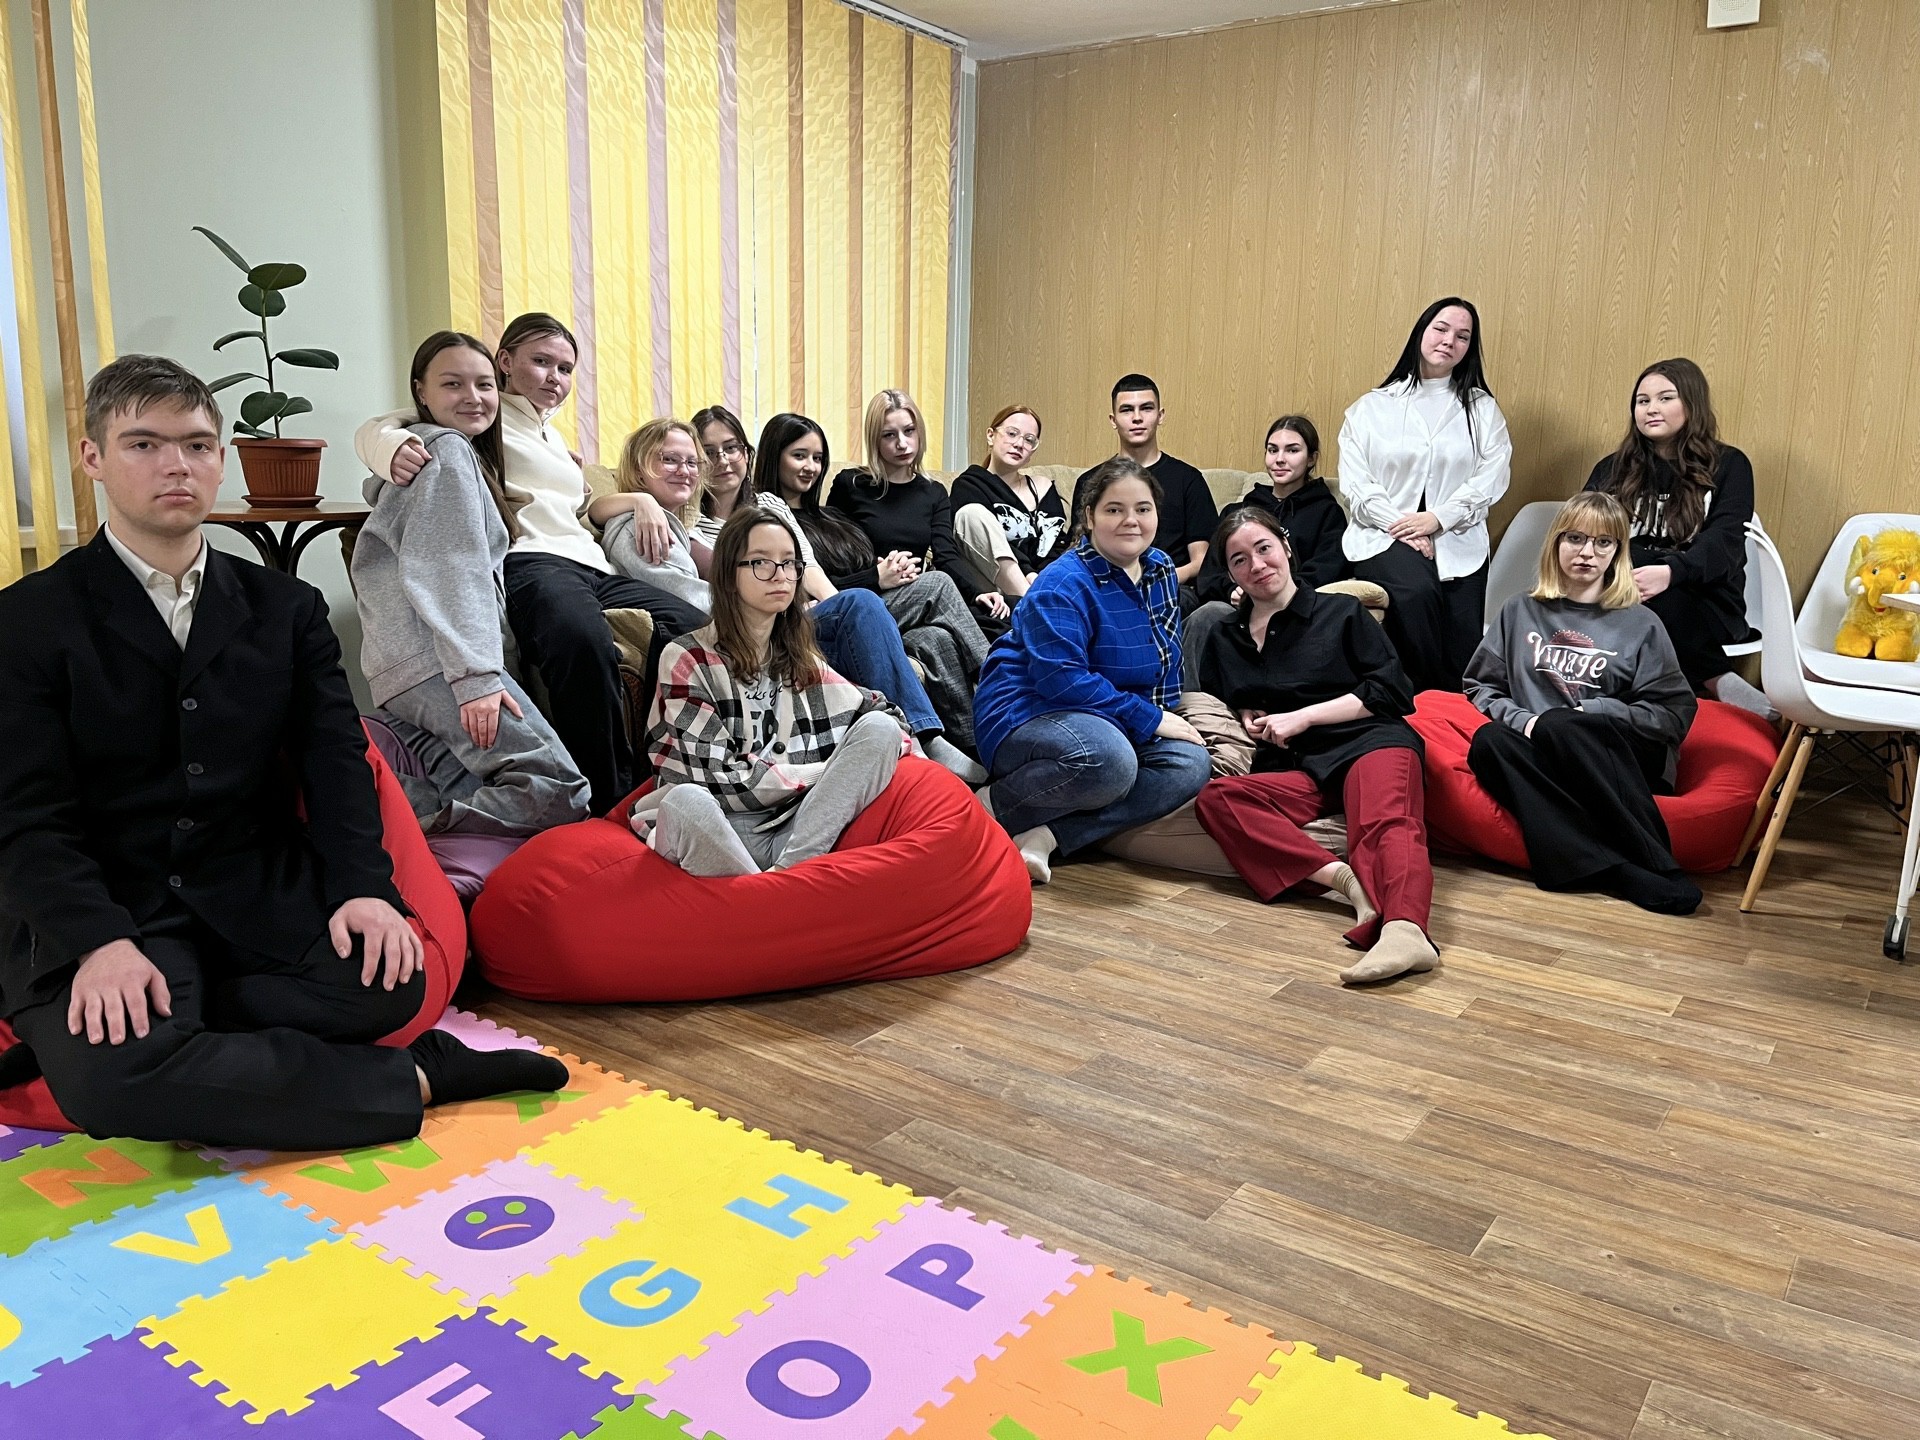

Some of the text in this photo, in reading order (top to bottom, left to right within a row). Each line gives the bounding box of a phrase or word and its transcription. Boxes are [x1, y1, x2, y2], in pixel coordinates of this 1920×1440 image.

[1528, 631, 1612, 679] Village
[19, 1147, 153, 1208] N
[110, 1204, 231, 1264] V
[579, 1174, 849, 1328] G H
[746, 1243, 985, 1420] O P
[1062, 1309, 1215, 1407] X
[378, 1362, 493, 1440] F
